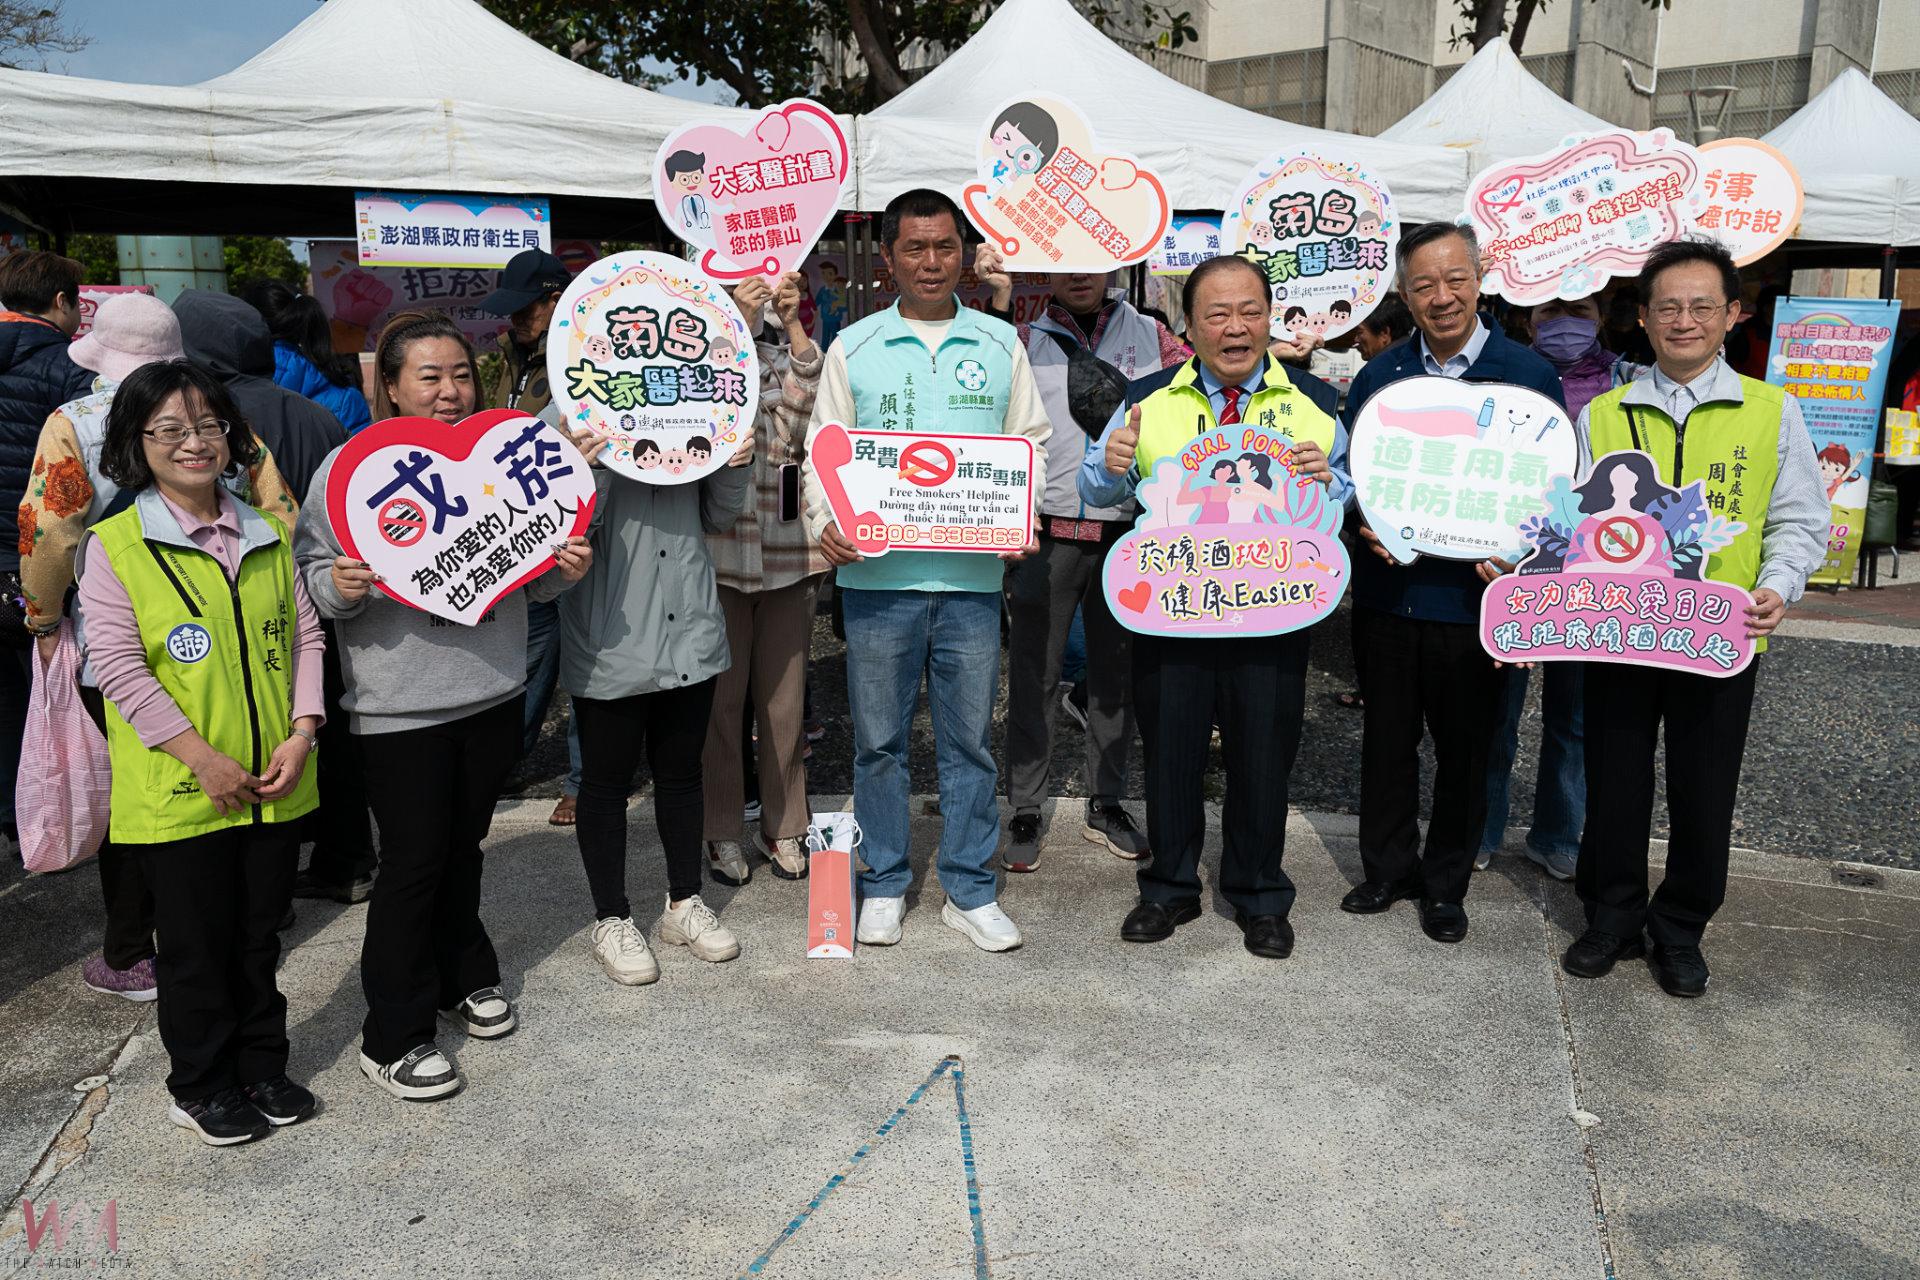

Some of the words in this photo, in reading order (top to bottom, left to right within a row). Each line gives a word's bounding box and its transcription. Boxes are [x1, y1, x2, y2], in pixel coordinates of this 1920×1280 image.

[709, 150, 835, 199] 大家醫計畫
[1051, 147, 1097, 191] 認識
[380, 225, 540, 249] 澎湖縣政府衛生局
[725, 203, 797, 233] 家庭醫師
[1035, 166, 1131, 260] 新興醫療科技
[1269, 189, 1357, 240] 菊島
[1487, 213, 1581, 262] 安心聊聊
[1587, 171, 1684, 225] 擁抱希望
[730, 226, 801, 256] 您的靠山
[1234, 237, 1387, 284] 大家醫起來
[605, 305, 710, 363] 菊島
[565, 358, 748, 412] 大家醫起來
[903, 373, 916, 431] 主任委員
[1260, 408, 1277, 428] 陳
[855, 438, 898, 469] 免費
[957, 461, 1027, 487] 戒菸專線
[1182, 433, 1231, 472] GIRL
[889, 487, 913, 498] Free
[967, 490, 1011, 502] Helpline
[1365, 474, 1544, 527] 預防齲齒
[1706, 462, 1726, 510] 周柏
[411, 498, 528, 596] 為你愛的人
[445, 498, 579, 612] 也為愛你的人
[856, 523, 1024, 546] 0800-636363
[1506, 578, 1731, 624] 女力綻放愛自己
[262, 618, 282, 673] 科長
[1493, 616, 1740, 669] 從拒菸檳酒做起
